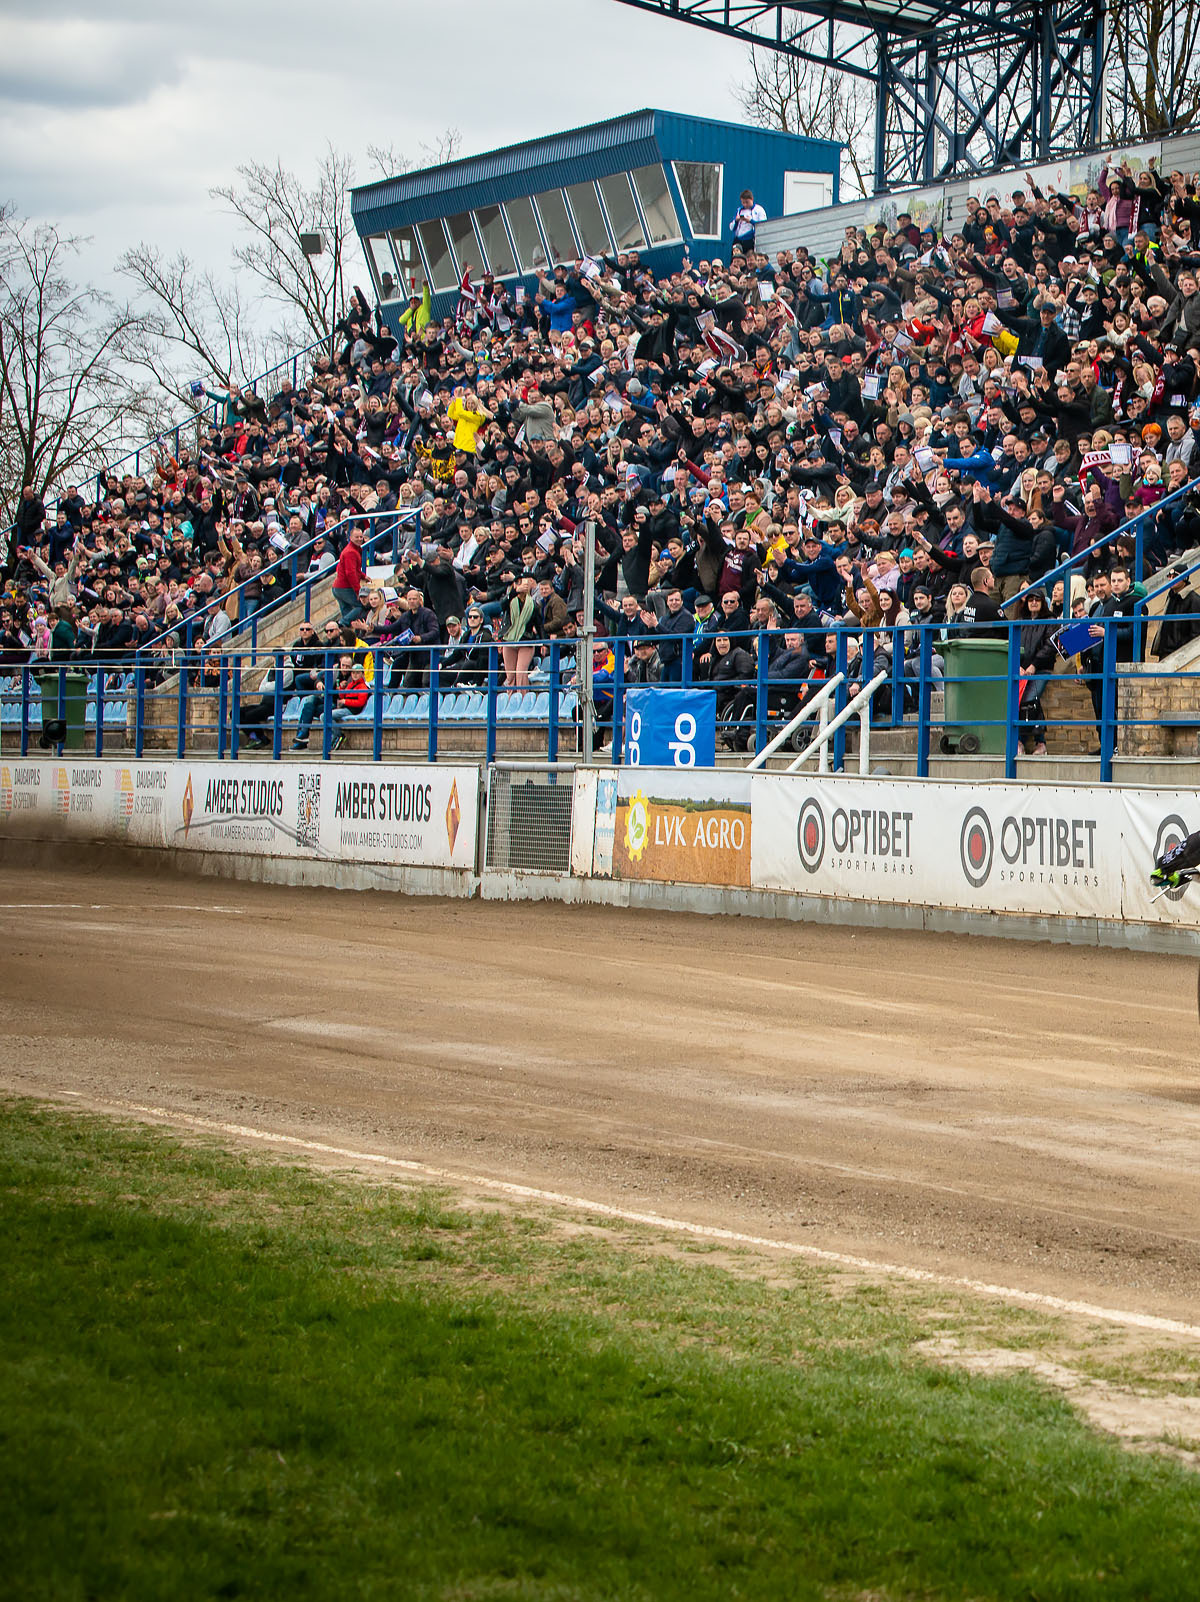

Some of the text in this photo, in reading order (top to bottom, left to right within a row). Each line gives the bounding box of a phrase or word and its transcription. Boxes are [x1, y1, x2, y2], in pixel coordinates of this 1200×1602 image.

[14, 768, 41, 786] DAUGAVPILS
[72, 768, 102, 788] DAUGAVPILS
[136, 769, 167, 790] DAUGAVPILS
[204, 778, 284, 816] AMBER STUDIOS
[334, 781, 432, 822] AMBER STUDIOS
[210, 824, 276, 841] WWW.AMBER-STUDIOS.COM
[341, 830, 423, 850] WWW.AMBER-STUDIOS.COM
[655, 815, 746, 850] LVK AGRO
[831, 807, 914, 858] OPTIBET
[1001, 815, 1097, 869] OPTIBET
[831, 857, 914, 876] SPORTA BĀRS
[1001, 870, 1099, 887] SPORTA BĀRS
